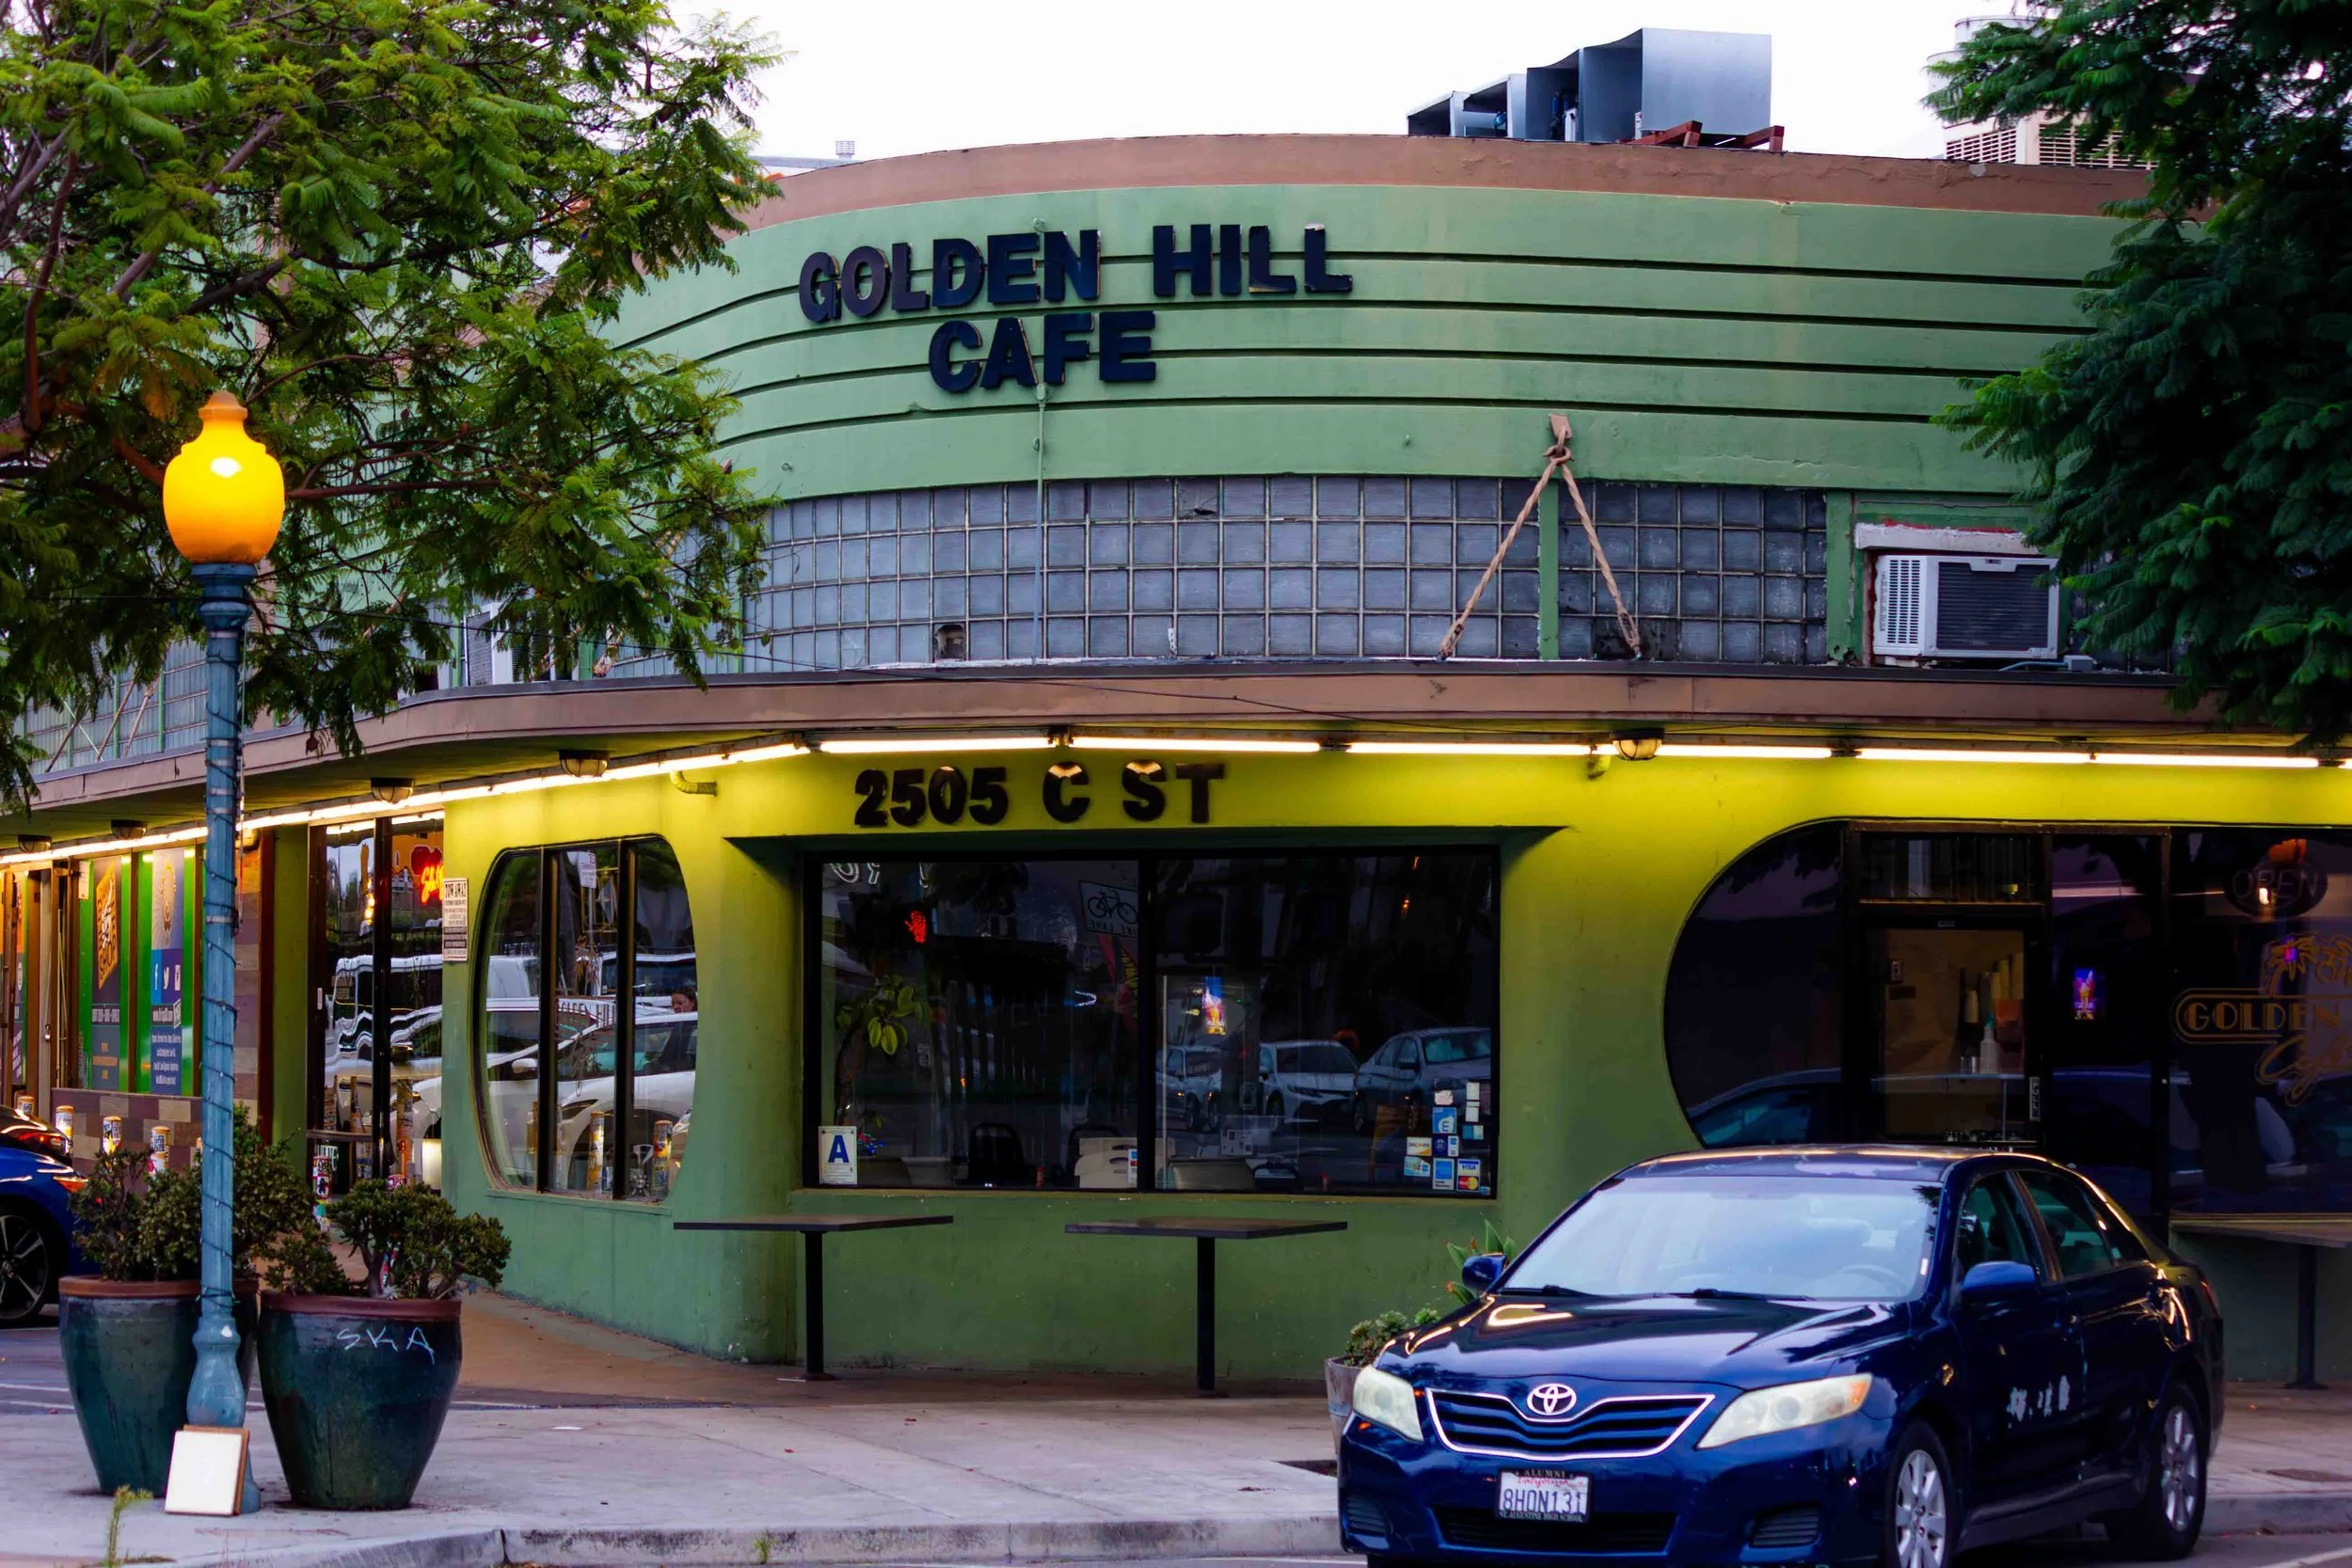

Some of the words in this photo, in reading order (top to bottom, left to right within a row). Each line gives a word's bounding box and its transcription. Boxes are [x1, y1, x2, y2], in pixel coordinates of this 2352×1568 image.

[799, 229, 1102, 323] GOLDEN
[1152, 223, 1353, 297] HILL
[929, 310, 1156, 392] CAFE
[854, 765, 1009, 828] 2505
[1042, 761, 1090, 823] C
[1122, 759, 1228, 823] ST
[2232, 869, 2319, 899] OPEN
[2186, 1002, 2342, 1032] GOLDEN
[828, 1134, 850, 1163] A
[336, 1325, 436, 1364] SKA
[1523, 1468, 1566, 1478] ALUMNI
